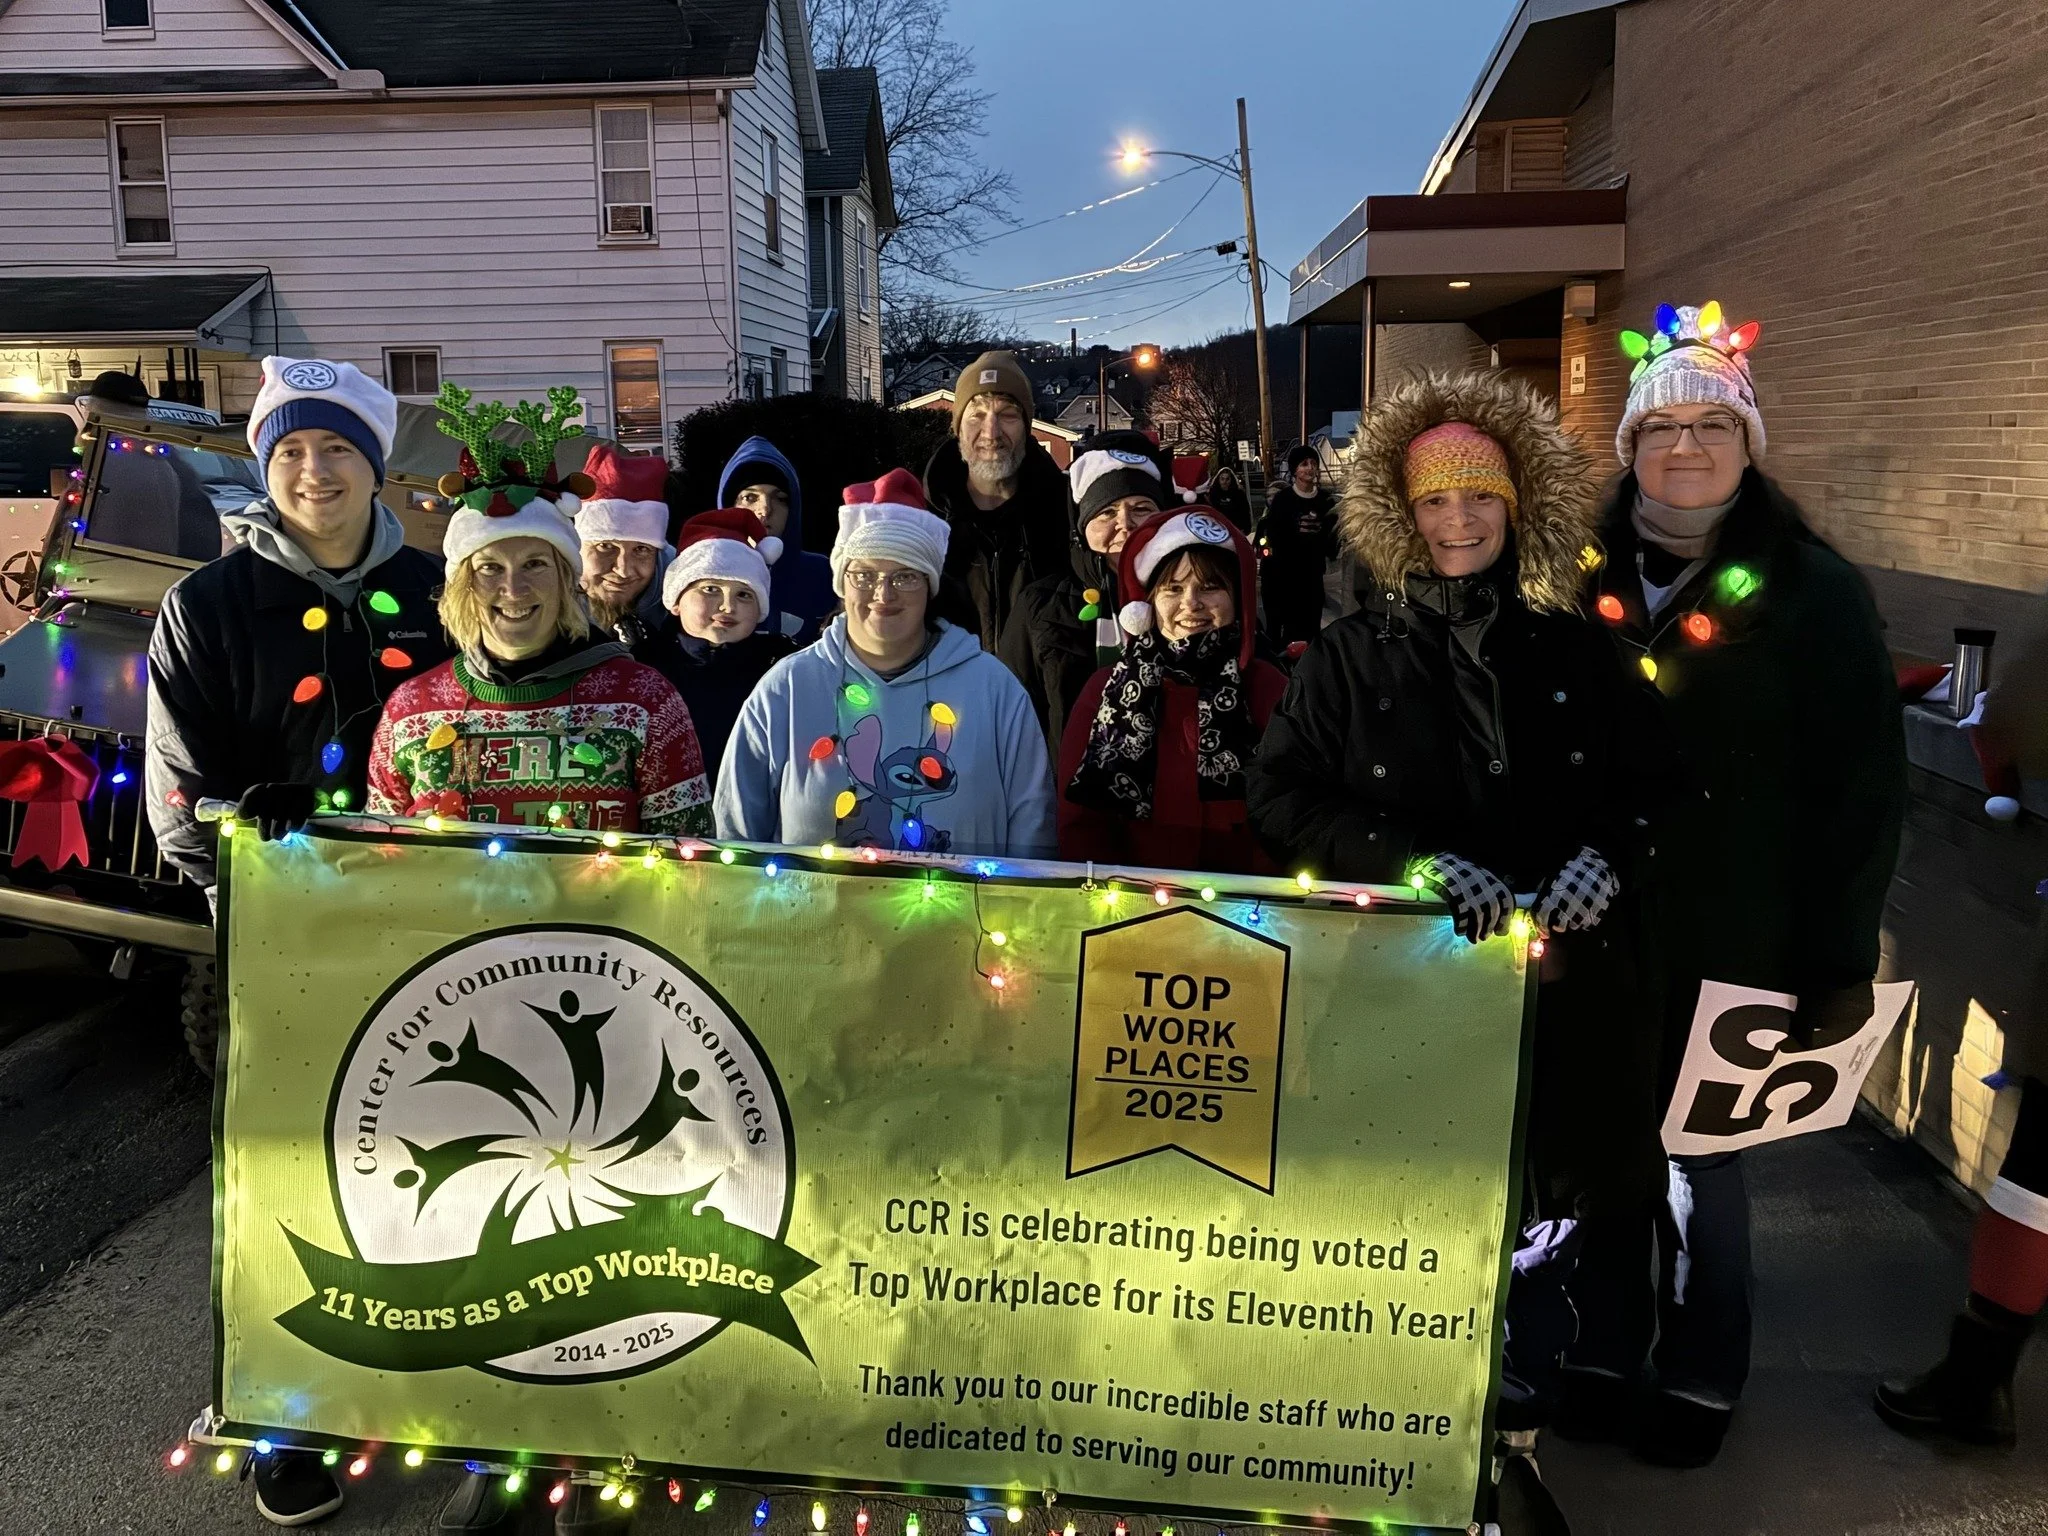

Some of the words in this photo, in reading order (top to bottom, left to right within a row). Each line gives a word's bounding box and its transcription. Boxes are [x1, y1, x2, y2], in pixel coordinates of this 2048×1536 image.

[1134, 971, 1231, 1011] TOP
[353, 1060, 395, 1176] Center
[386, 1007, 435, 1057] for
[435, 951, 648, 1007] Community
[651, 981, 769, 1147] Resources
[1106, 1047, 1250, 1083] PLACES
[1124, 1014, 1236, 1049] WORK
[1125, 1089, 1223, 1123] 2025
[886, 1199, 950, 1235] CCR
[962, 1202, 989, 1238] is
[1001, 1207, 1195, 1261] celebrating
[1207, 1224, 1299, 1272] being
[1313, 1238, 1407, 1271] voted
[1419, 1246, 1438, 1273] a
[320, 1286, 355, 1321] 11
[363, 1298, 457, 1331] Years
[464, 1300, 501, 1327] as
[507, 1289, 529, 1312] a
[529, 1260, 595, 1303] Top
[595, 1247, 774, 1294] Workplace
[849, 1262, 910, 1306] Top
[923, 1266, 1100, 1312] Workplace
[1114, 1279, 1161, 1316] for
[1173, 1285, 1214, 1320] its
[1227, 1291, 1373, 1333] Eleventh
[1387, 1303, 1476, 1341] Year!
[554, 1343, 606, 1363] 2014
[624, 1323, 675, 1352] 2025
[858, 1365, 944, 1398] Thank
[955, 1374, 1004, 1407] you
[1015, 1372, 1042, 1400] to
[1051, 1379, 1098, 1404] our
[1107, 1379, 1249, 1422] incredible
[1259, 1398, 1328, 1428] staff
[1337, 1404, 1394, 1433] who
[1404, 1412, 1452, 1436] are
[886, 1422, 1026, 1453] dedicated
[1036, 1427, 1062, 1454] to
[1072, 1435, 1178, 1476] serving
[1187, 1450, 1235, 1476] our
[1243, 1452, 1414, 1495] community!
